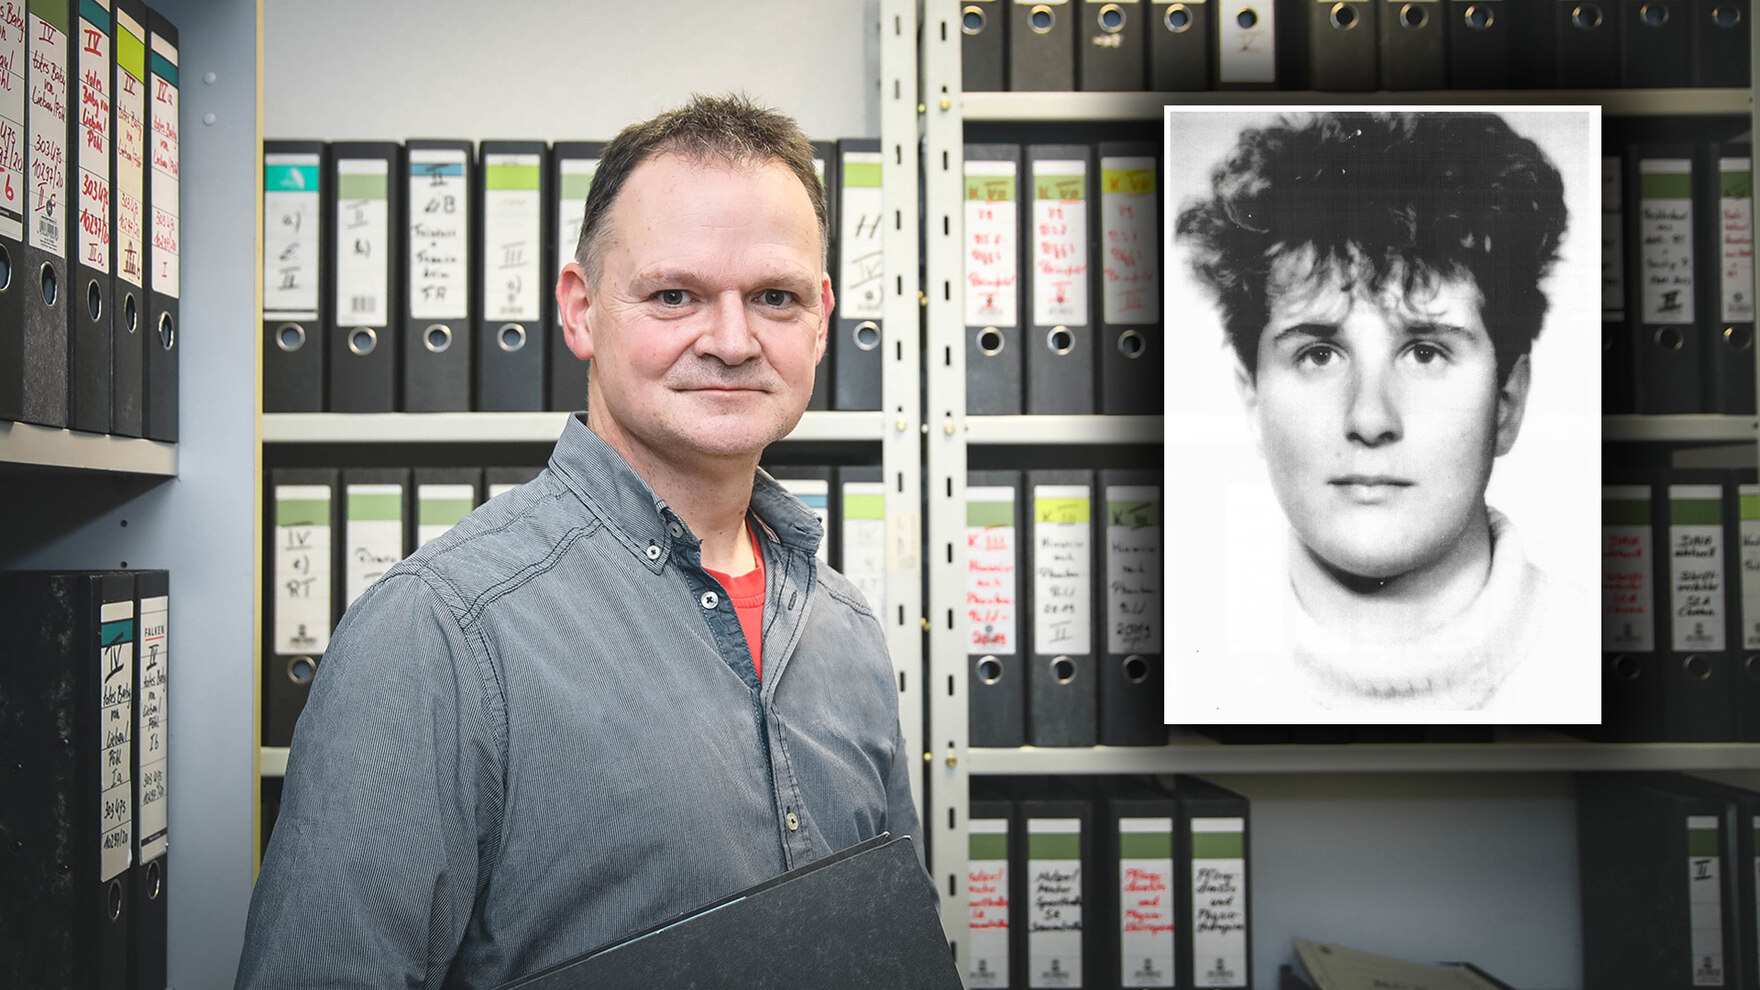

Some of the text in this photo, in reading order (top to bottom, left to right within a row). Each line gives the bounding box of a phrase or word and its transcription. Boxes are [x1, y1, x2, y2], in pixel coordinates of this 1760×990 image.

[6, 2, 24, 43] Baby
[39, 21, 57, 45] IV
[84, 29, 102, 57] IV
[144, 625, 164, 637] FALKEN
[105, 632, 124, 684] IV
